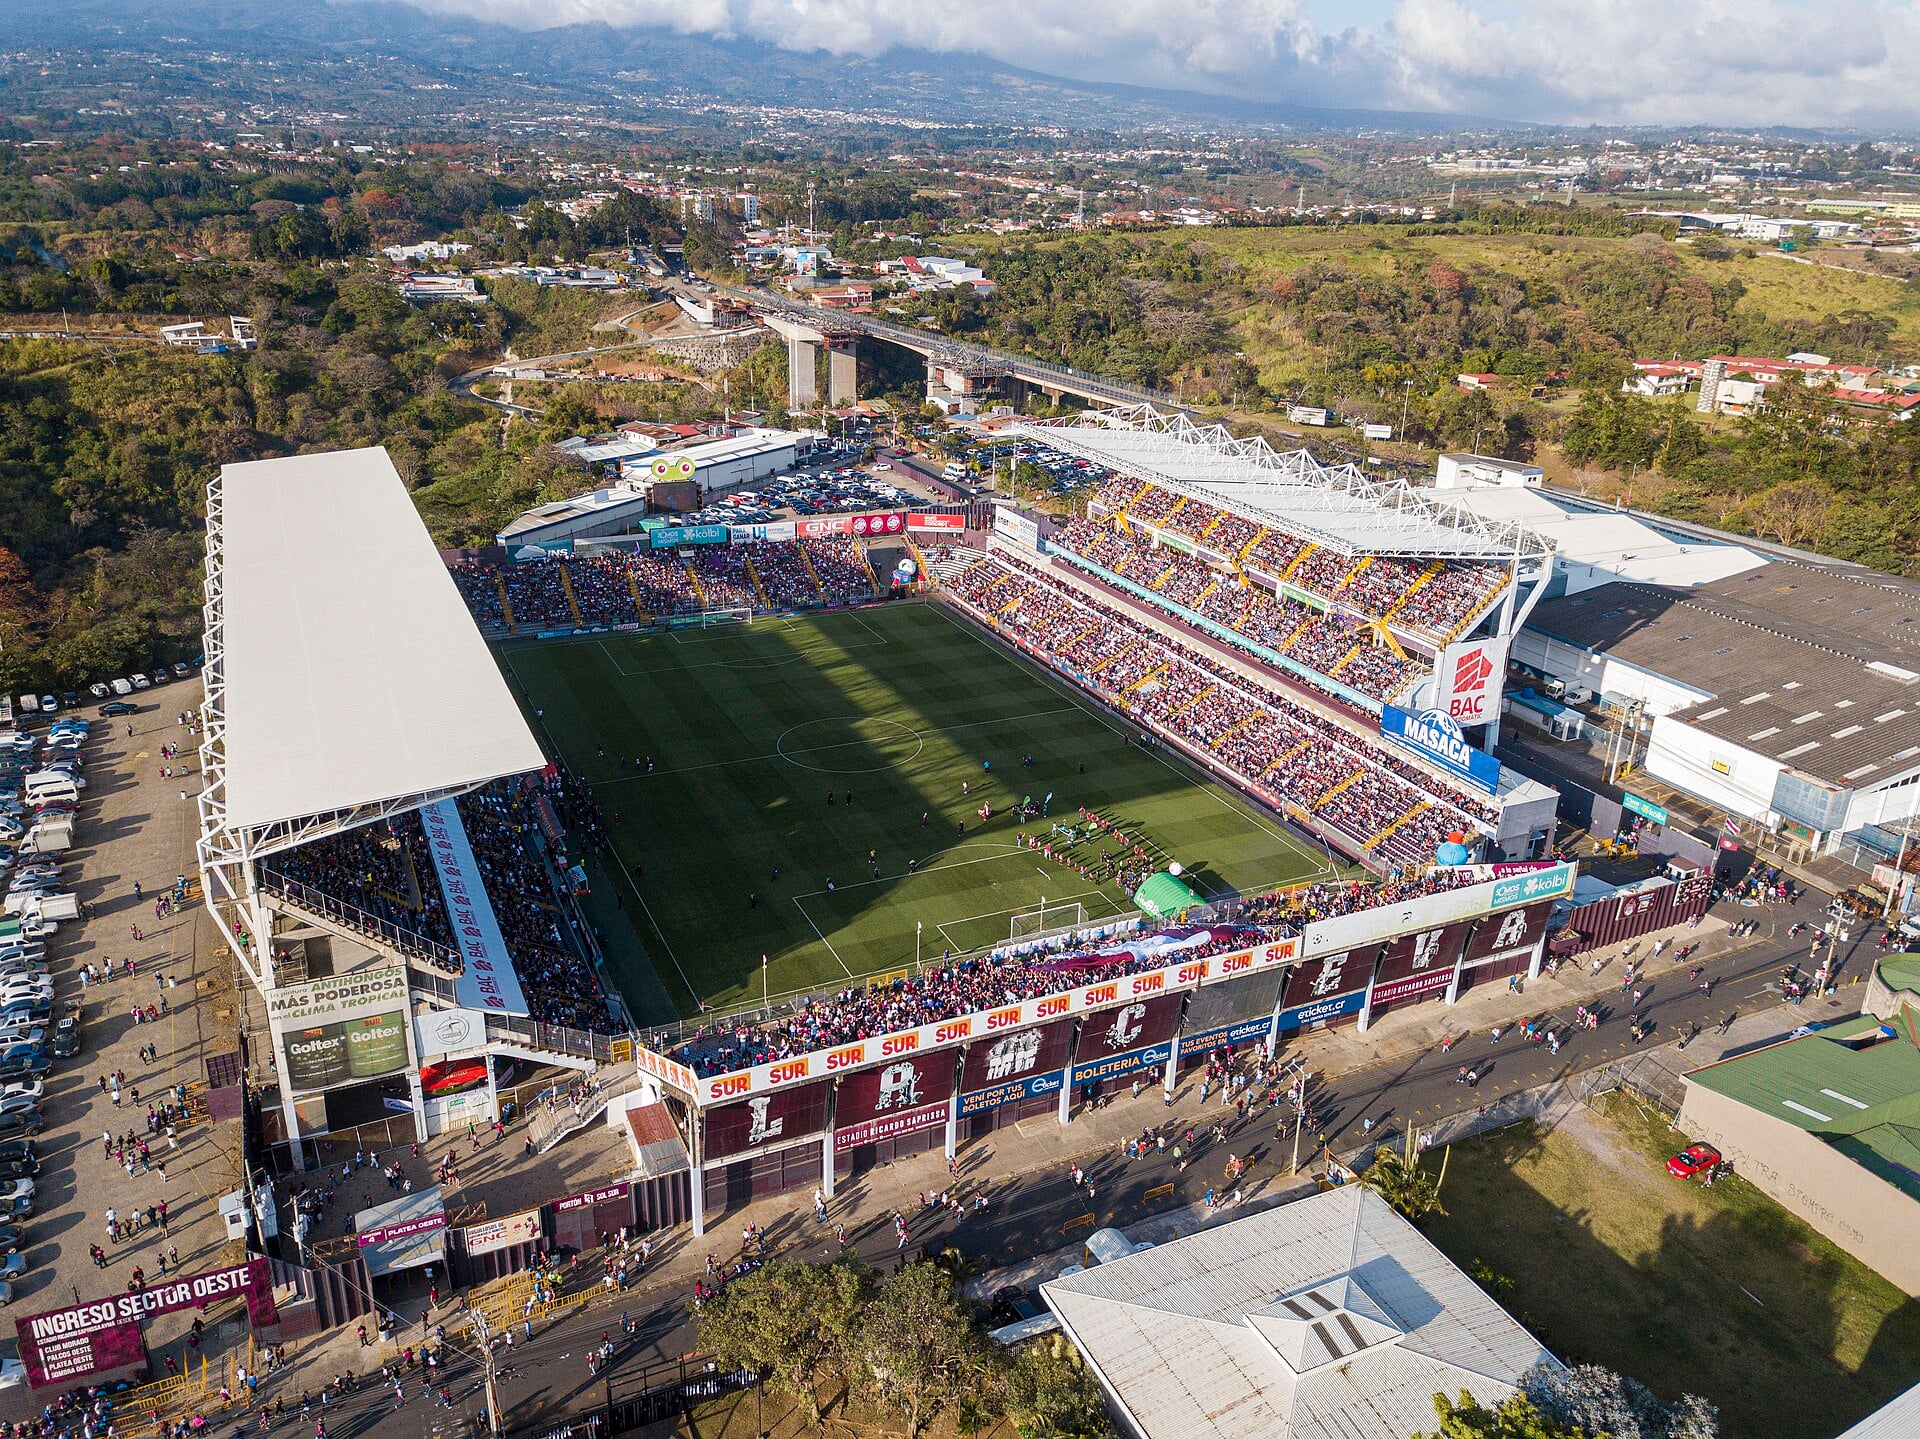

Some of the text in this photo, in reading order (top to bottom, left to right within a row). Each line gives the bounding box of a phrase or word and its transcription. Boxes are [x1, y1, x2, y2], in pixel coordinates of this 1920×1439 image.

[805, 520, 844, 532] GNC
[547, 548, 568, 558] INS
[1450, 695, 1486, 718] BAC
[1404, 716, 1470, 767] MASACA
[441, 851, 454, 865] BAC
[449, 878, 463, 894] BAC
[1538, 874, 1567, 891] kölbi
[458, 908, 473, 925] BAC
[468, 941, 483, 958] BAC
[280, 988, 308, 998] pintura
[311, 968, 403, 992] ANTIHONGOS
[479, 975, 495, 994] BAC
[1374, 987, 1397, 1000] ESTADIO
[1398, 980, 1423, 994] RICARDO
[1424, 973, 1453, 987] SAPRISSA
[271, 978, 405, 1011] MÁS PODEROSA
[292, 1004, 336, 1019] CLIMA
[341, 989, 407, 1009] TROPICAL
[710, 1077, 748, 1099] SUR
[769, 1063, 806, 1084] SUR
[826, 1048, 862, 1070] SUR
[882, 1035, 916, 1056] SUR
[935, 1022, 969, 1043] SUR
[987, 1010, 1019, 1030] SUR
[1037, 998, 1068, 1018] SUR
[1085, 986, 1115, 1006] SUR
[1132, 976, 1162, 995] SUR
[1178, 964, 1207, 984] SUR
[1222, 955, 1250, 973] SUR
[1265, 945, 1292, 963] SUR
[350, 1025, 400, 1043] Goltex
[1181, 1031, 1229, 1049] TUS EVENTOS
[290, 1036, 340, 1055] Goltex
[1180, 1037, 1227, 1055] FAVORITOS EN
[1075, 1056, 1141, 1081] BOLETERIA
[962, 1090, 1026, 1113] BOLETOS AQUÍ
[963, 1083, 1023, 1104] VENÍ POR TUS
[837, 1129, 868, 1145] ESTADIO
[869, 1119, 905, 1136] RICARDO
[906, 1108, 946, 1126] SAPRISSA
[596, 1192, 607, 1201] SOL
[607, 1188, 620, 1197] SUR
[387, 1218, 443, 1236] PLATEA OESTE
[469, 1230, 508, 1246] GNC
[31, 1267, 251, 1339] INGRESO SECTOR OESTE
[45, 1337, 89, 1354] CLUB MORADO
[47, 1345, 92, 1363] PALCOS OESTE
[49, 1353, 94, 1371] PLATEA OESTE
[51, 1362, 95, 1379] SOMBRA OESTE
